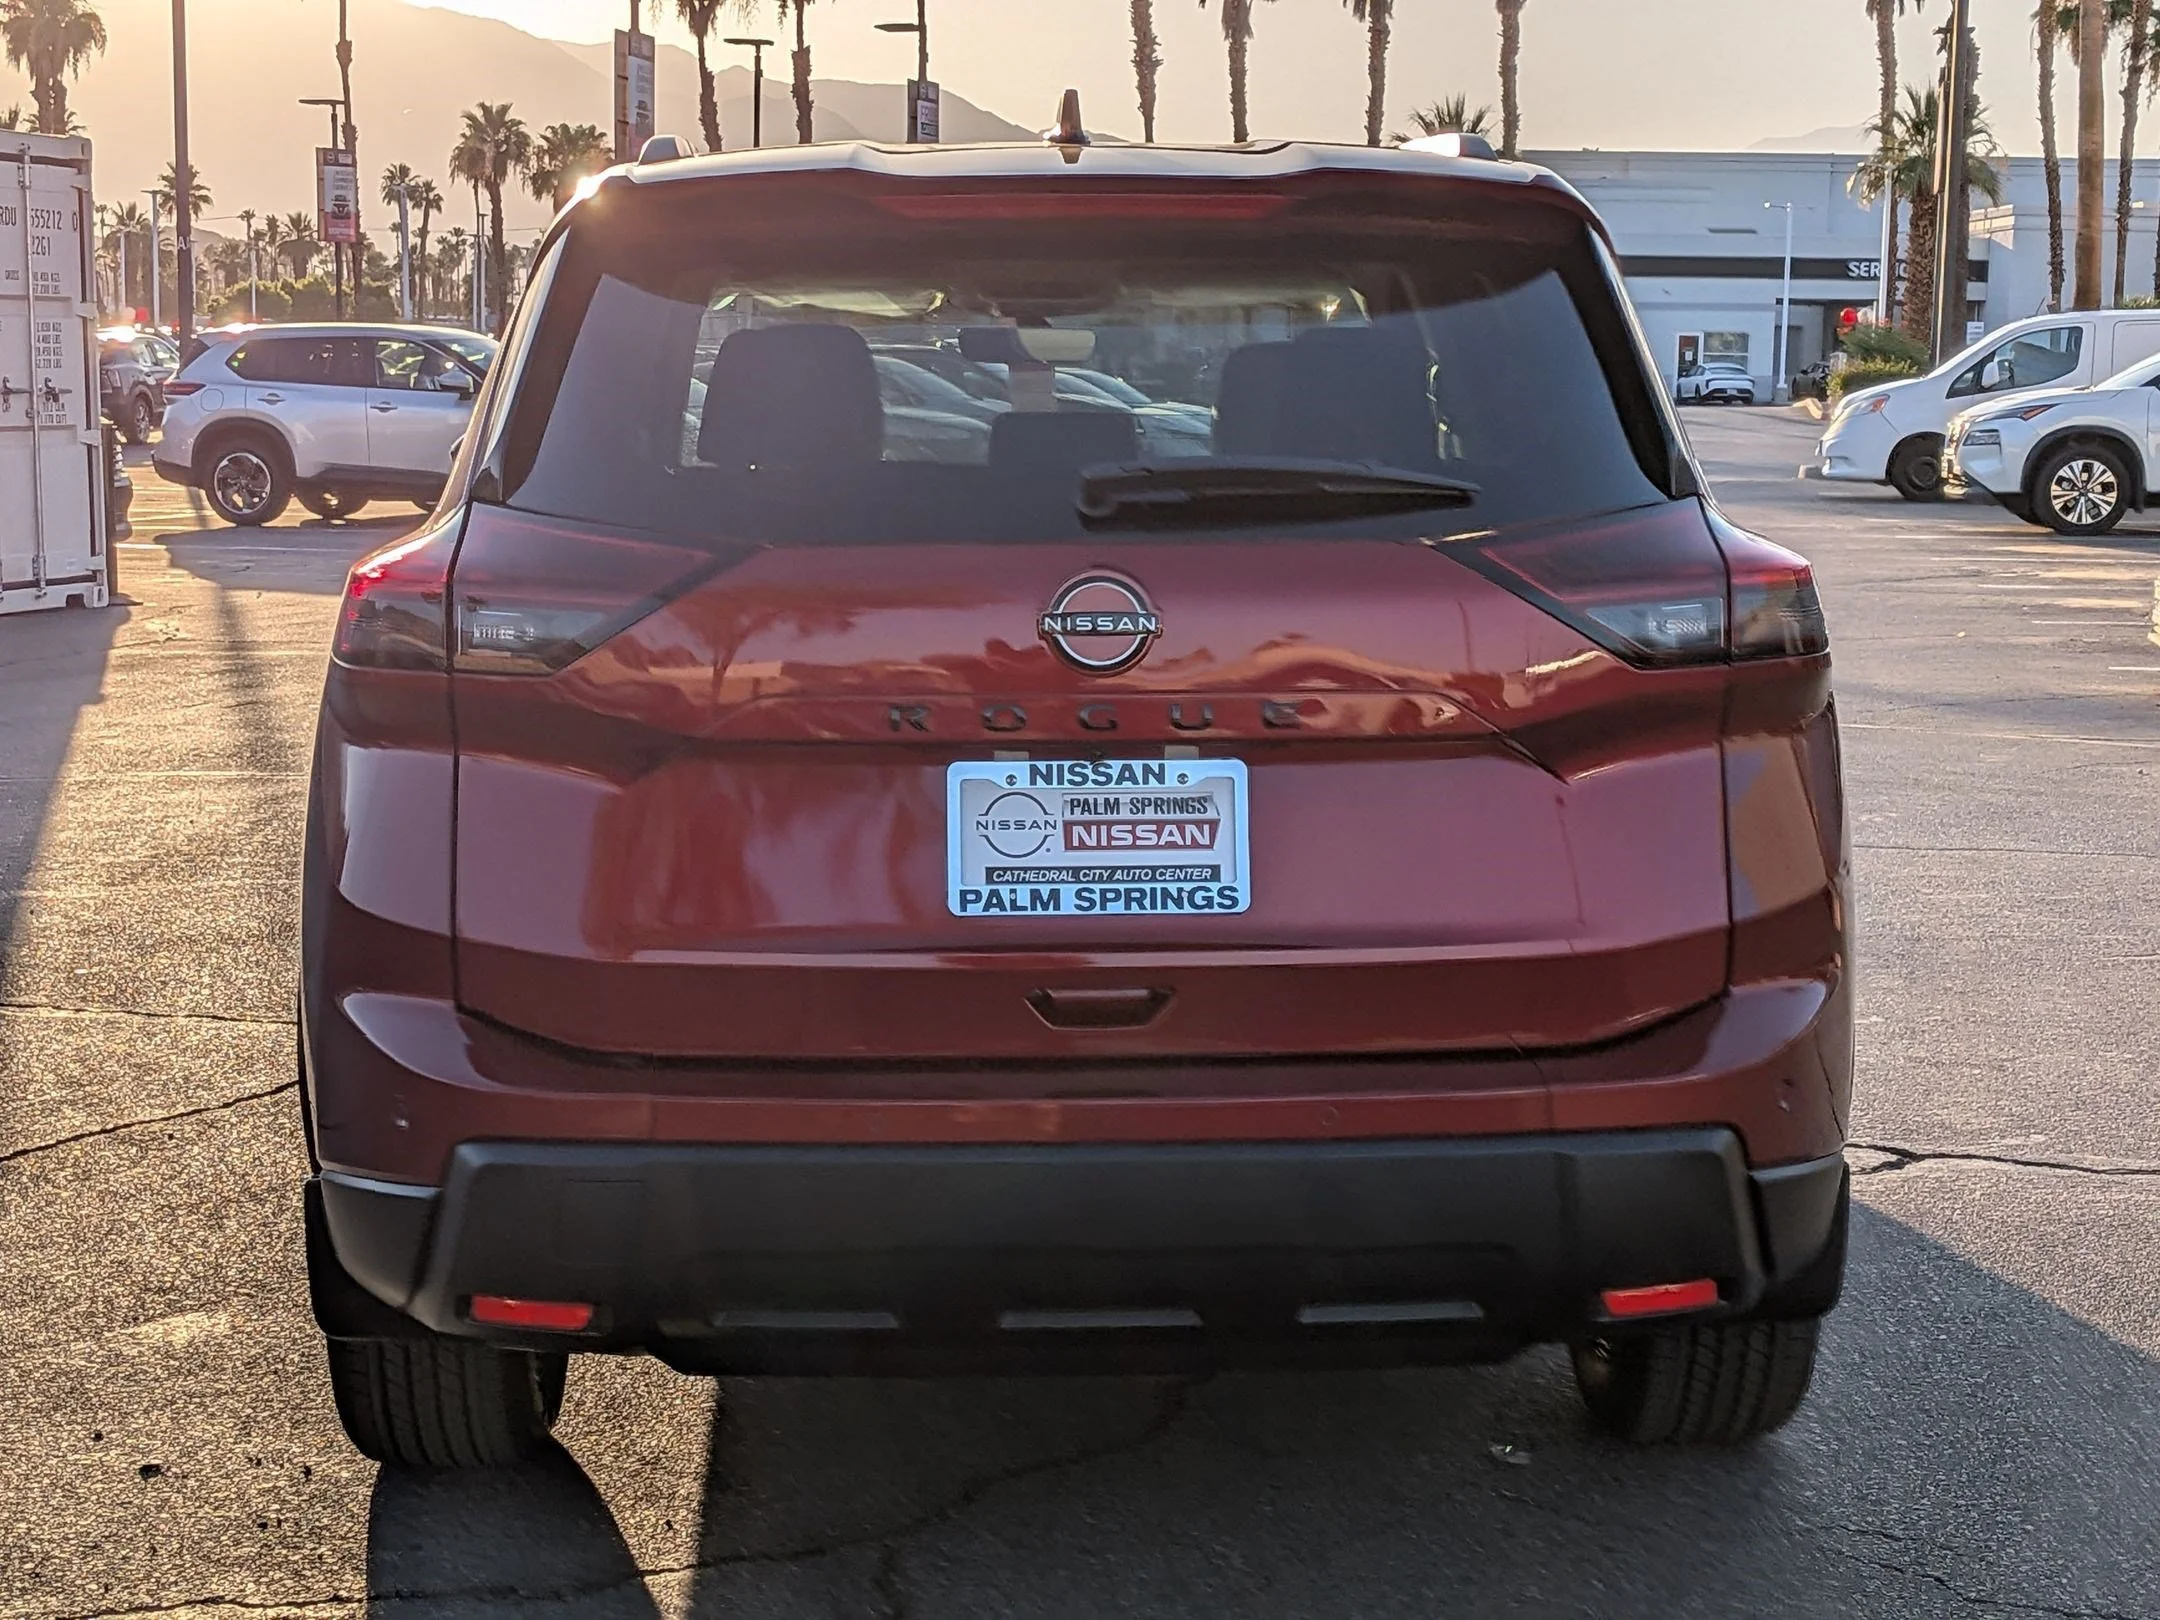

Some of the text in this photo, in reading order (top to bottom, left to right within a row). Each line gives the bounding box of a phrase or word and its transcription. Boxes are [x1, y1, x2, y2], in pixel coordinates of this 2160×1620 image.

[1044, 616, 1157, 632] NISSAN
[888, 702, 1301, 733] ROGUE
[1029, 763, 1166, 787] NISSAN
[1070, 796, 1208, 816] PALM SPRINGS
[976, 819, 1057, 831] NISSAN
[1072, 824, 1210, 847] NISSAN
[992, 868, 1212, 882] CATHEDRAL CITY AUTO CENTER
[959, 885, 1240, 912] PALM SPRINGS
